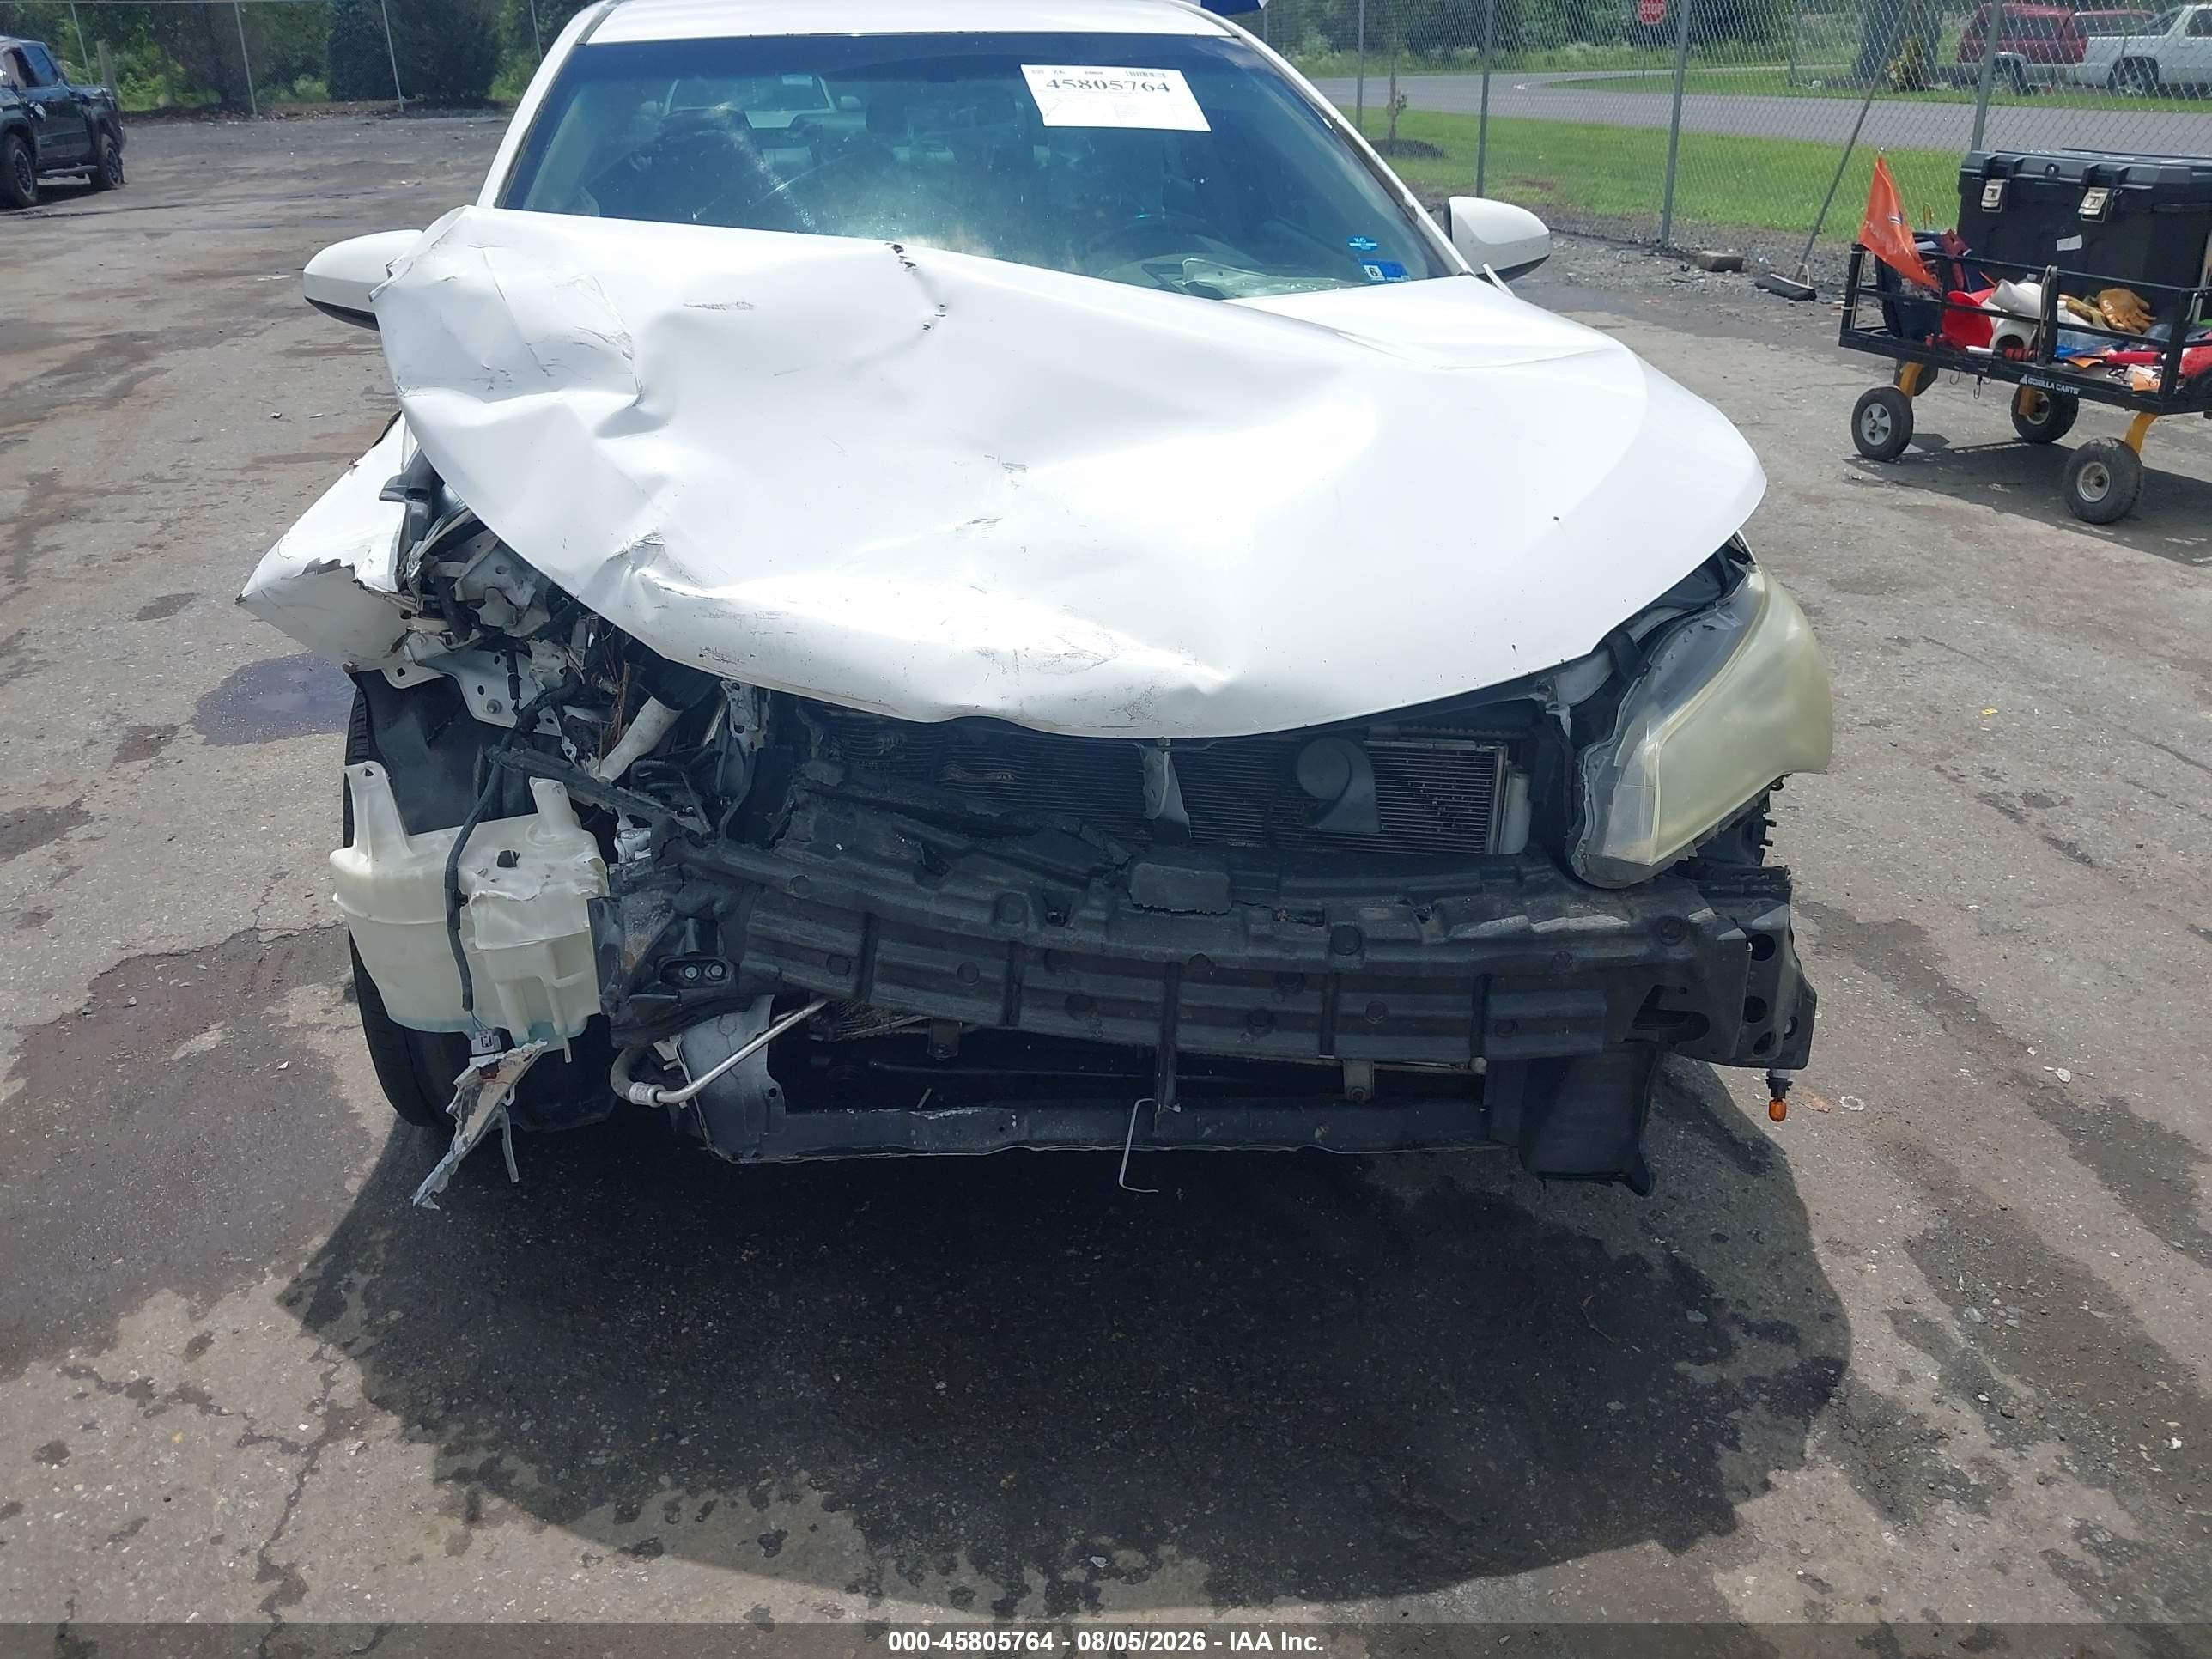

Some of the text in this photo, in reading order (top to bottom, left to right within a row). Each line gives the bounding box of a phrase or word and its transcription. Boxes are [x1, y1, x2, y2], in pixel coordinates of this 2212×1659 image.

[1641, 3, 1664, 15] STOP
[1046, 78, 1170, 93] 45805764
[2027, 378, 2080, 395] GORILLA CARTS
